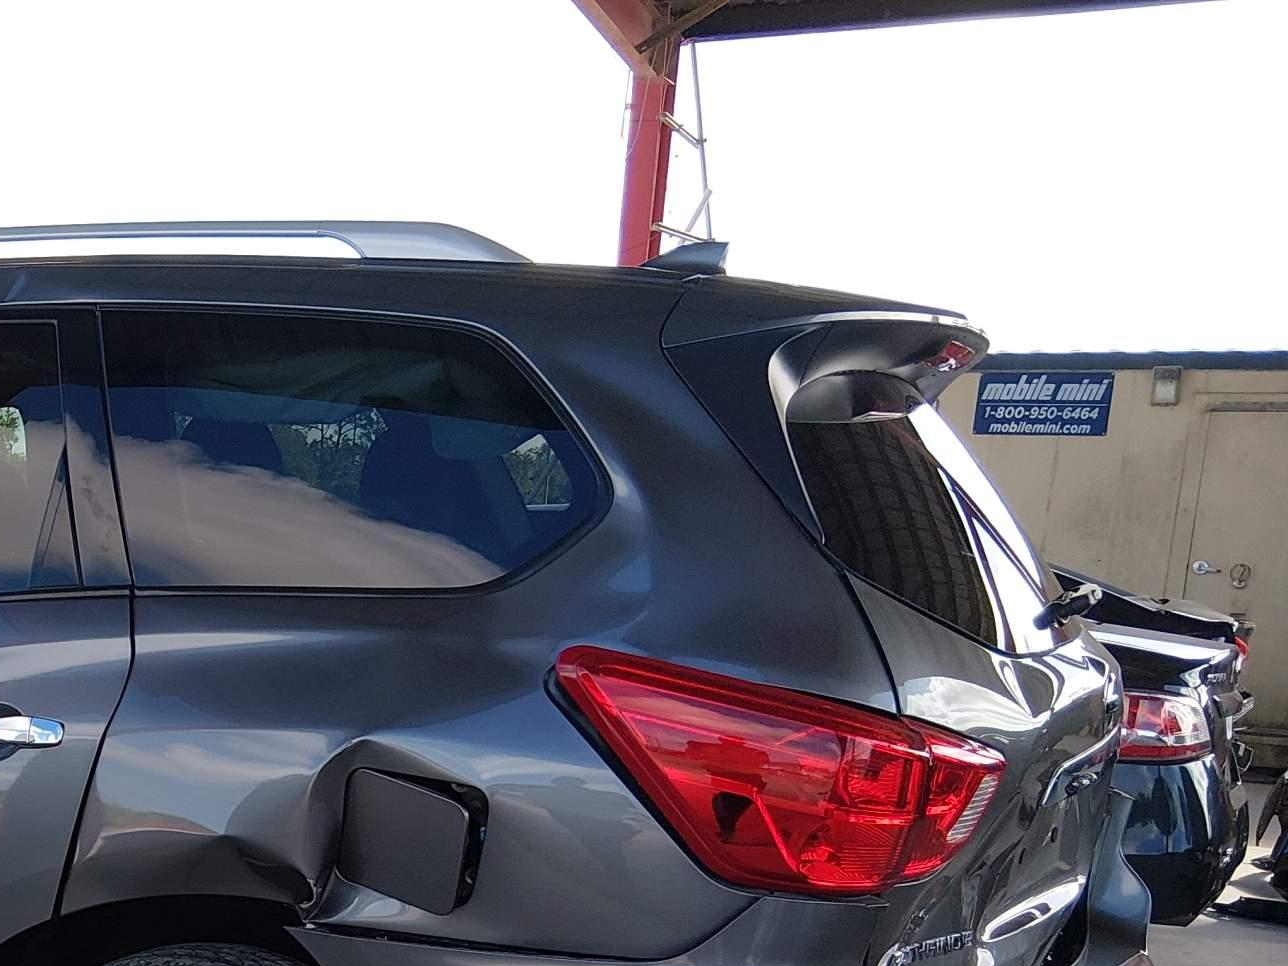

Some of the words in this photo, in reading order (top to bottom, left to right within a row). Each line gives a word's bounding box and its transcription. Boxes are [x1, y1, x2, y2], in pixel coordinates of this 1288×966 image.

[981, 375, 1055, 400] mobile
[1056, 379, 1109, 400] mini
[984, 406, 1099, 419] 1-800-950-6464
[988, 421, 1091, 433] mobilemini.com
